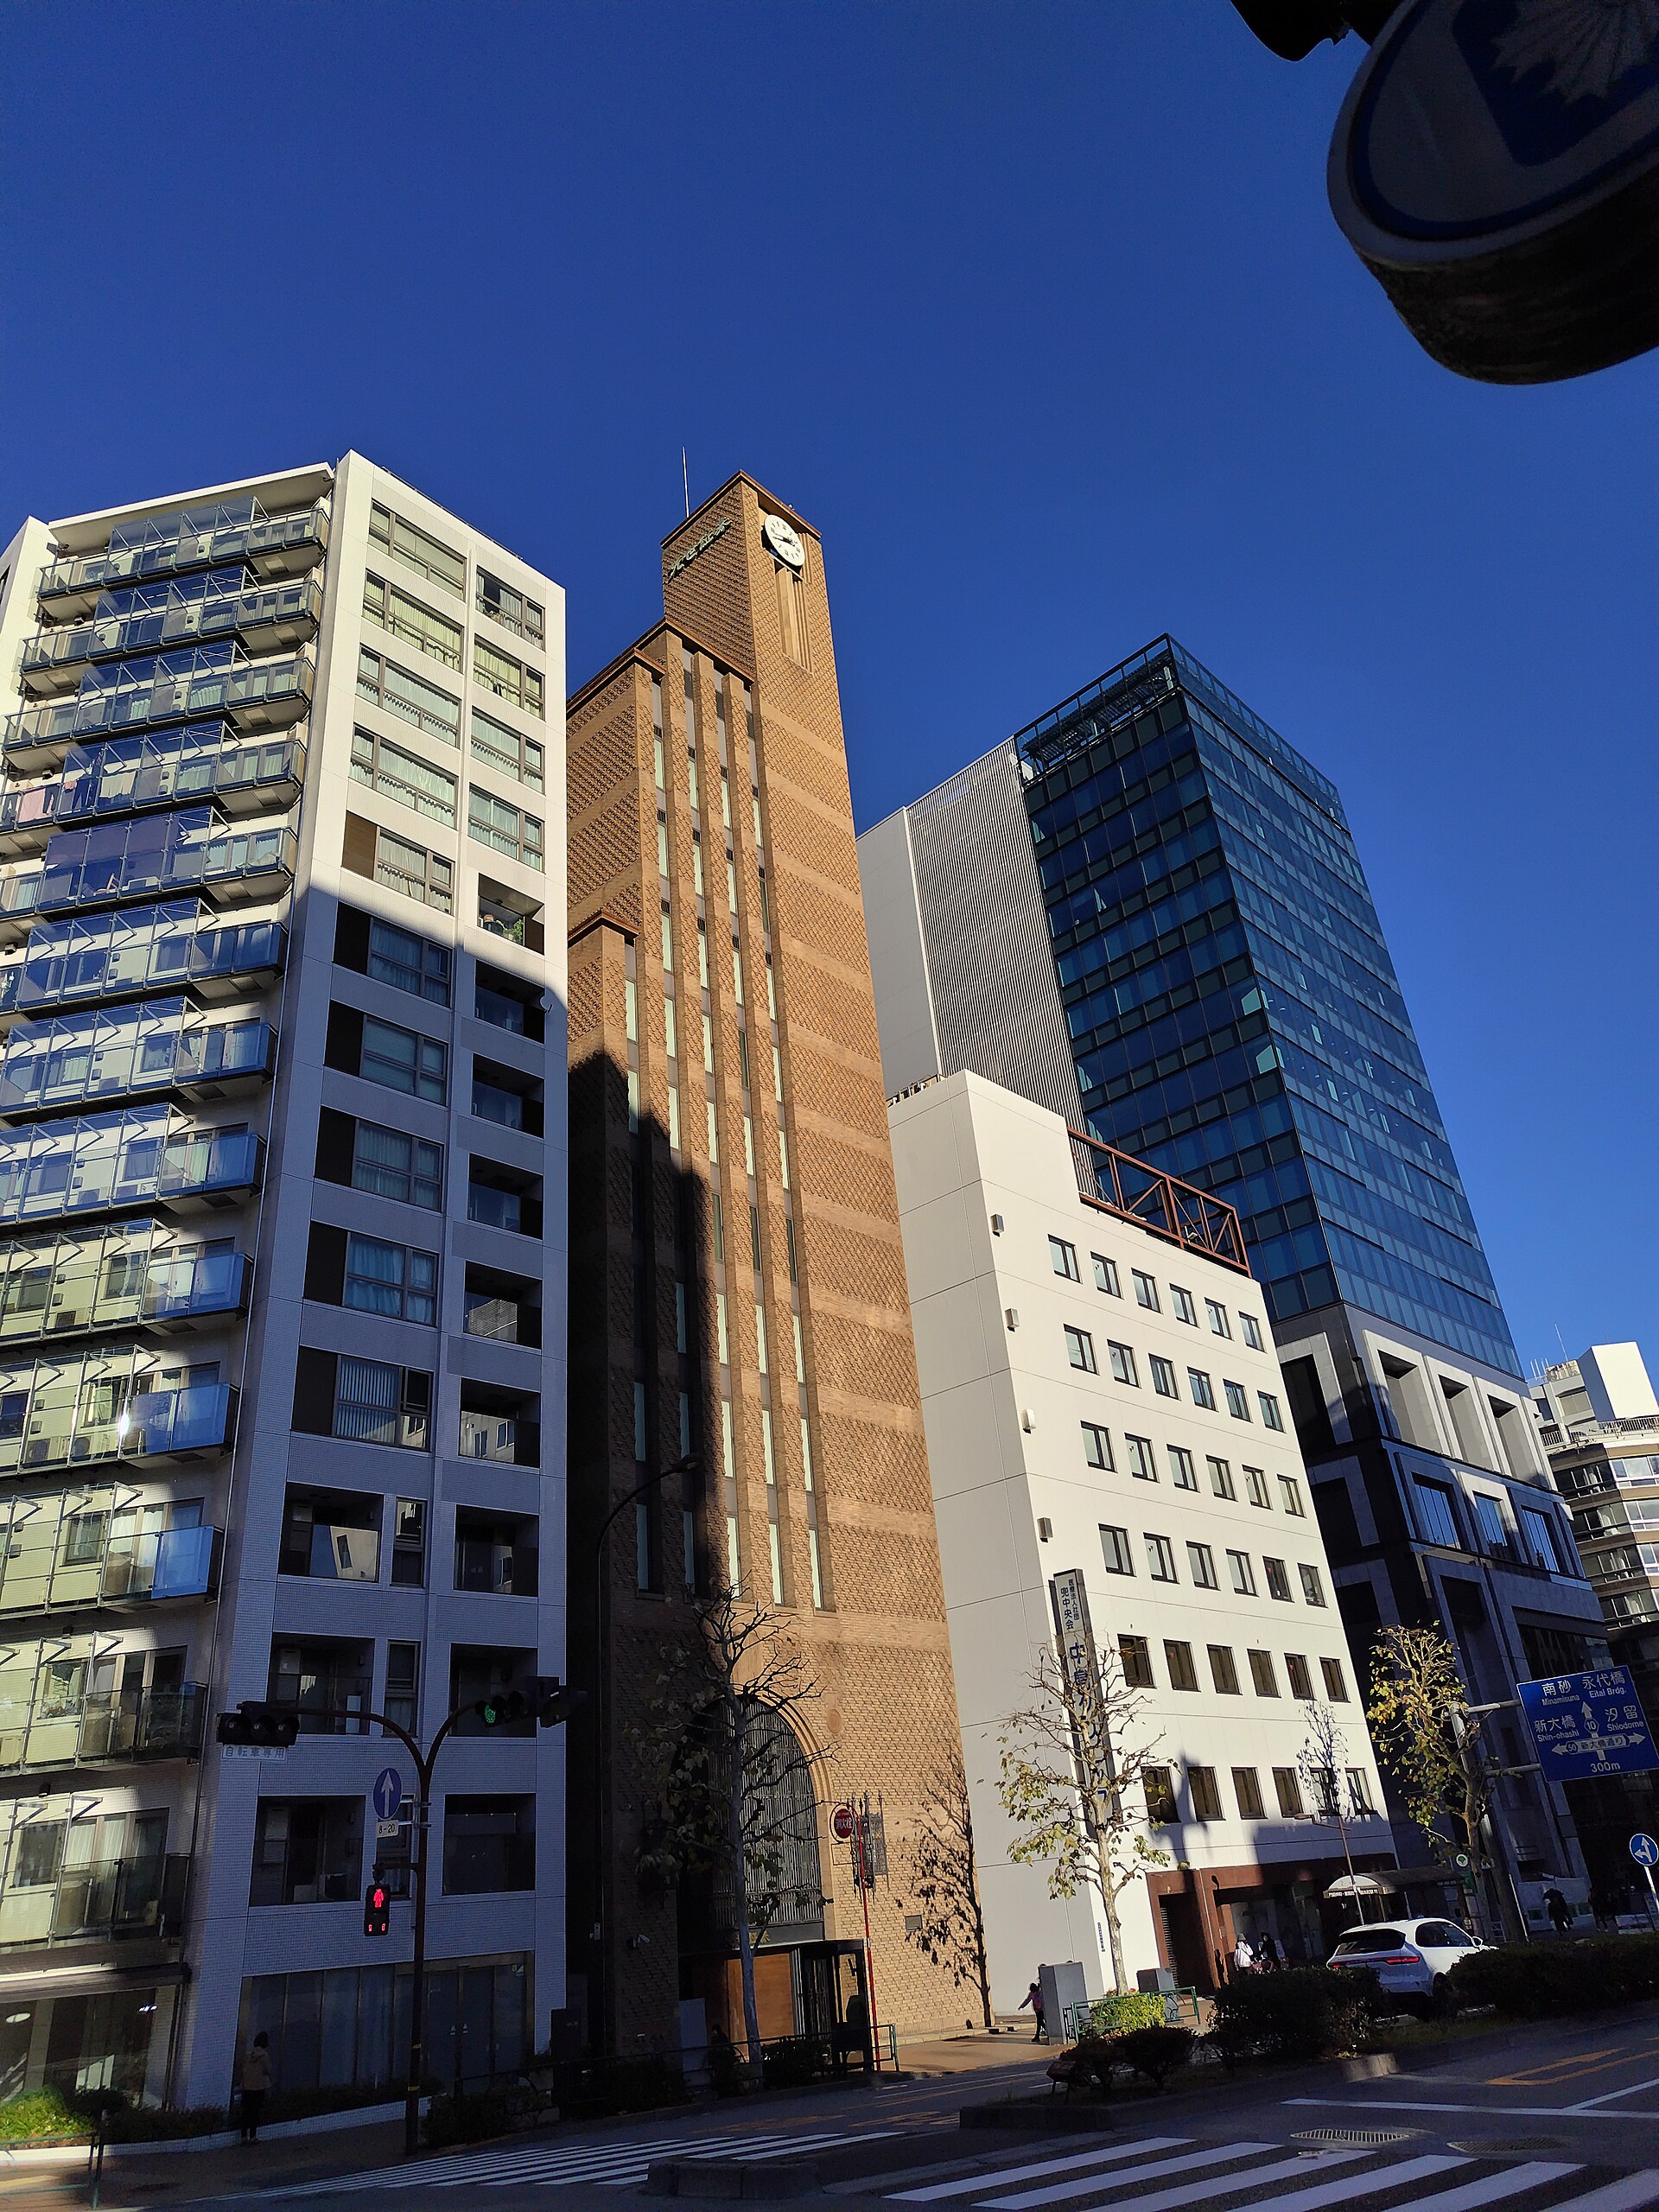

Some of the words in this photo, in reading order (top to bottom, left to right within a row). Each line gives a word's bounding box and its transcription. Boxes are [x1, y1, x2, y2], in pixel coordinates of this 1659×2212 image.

[1060, 1587, 1074, 1630] 兜中央会
[1581, 1670, 1625, 1690] 永代橋
[1541, 1679, 1572, 1697] 南砂
[1589, 1689, 1605, 1699] Eitai
[1606, 1687, 1627, 1696] Brdg.
[1541, 1694, 1580, 1707] Minamisuna
[1605, 1705, 1638, 1722] 汐留
[1534, 1714, 1576, 1733] 新大橋
[1586, 1720, 1597, 1731] 10
[1606, 1720, 1644, 1732] Shiodome
[1537, 1729, 1580, 1743] Shin-ohashi
[1580, 1736, 1624, 1750] 新大橋通り
[226, 1745, 284, 1758] 自転車専用
[1590, 1761, 1621, 1773] 300m
[378, 1823, 396, 1834] 8-20
[835, 1817, 853, 1830] 消火栓
